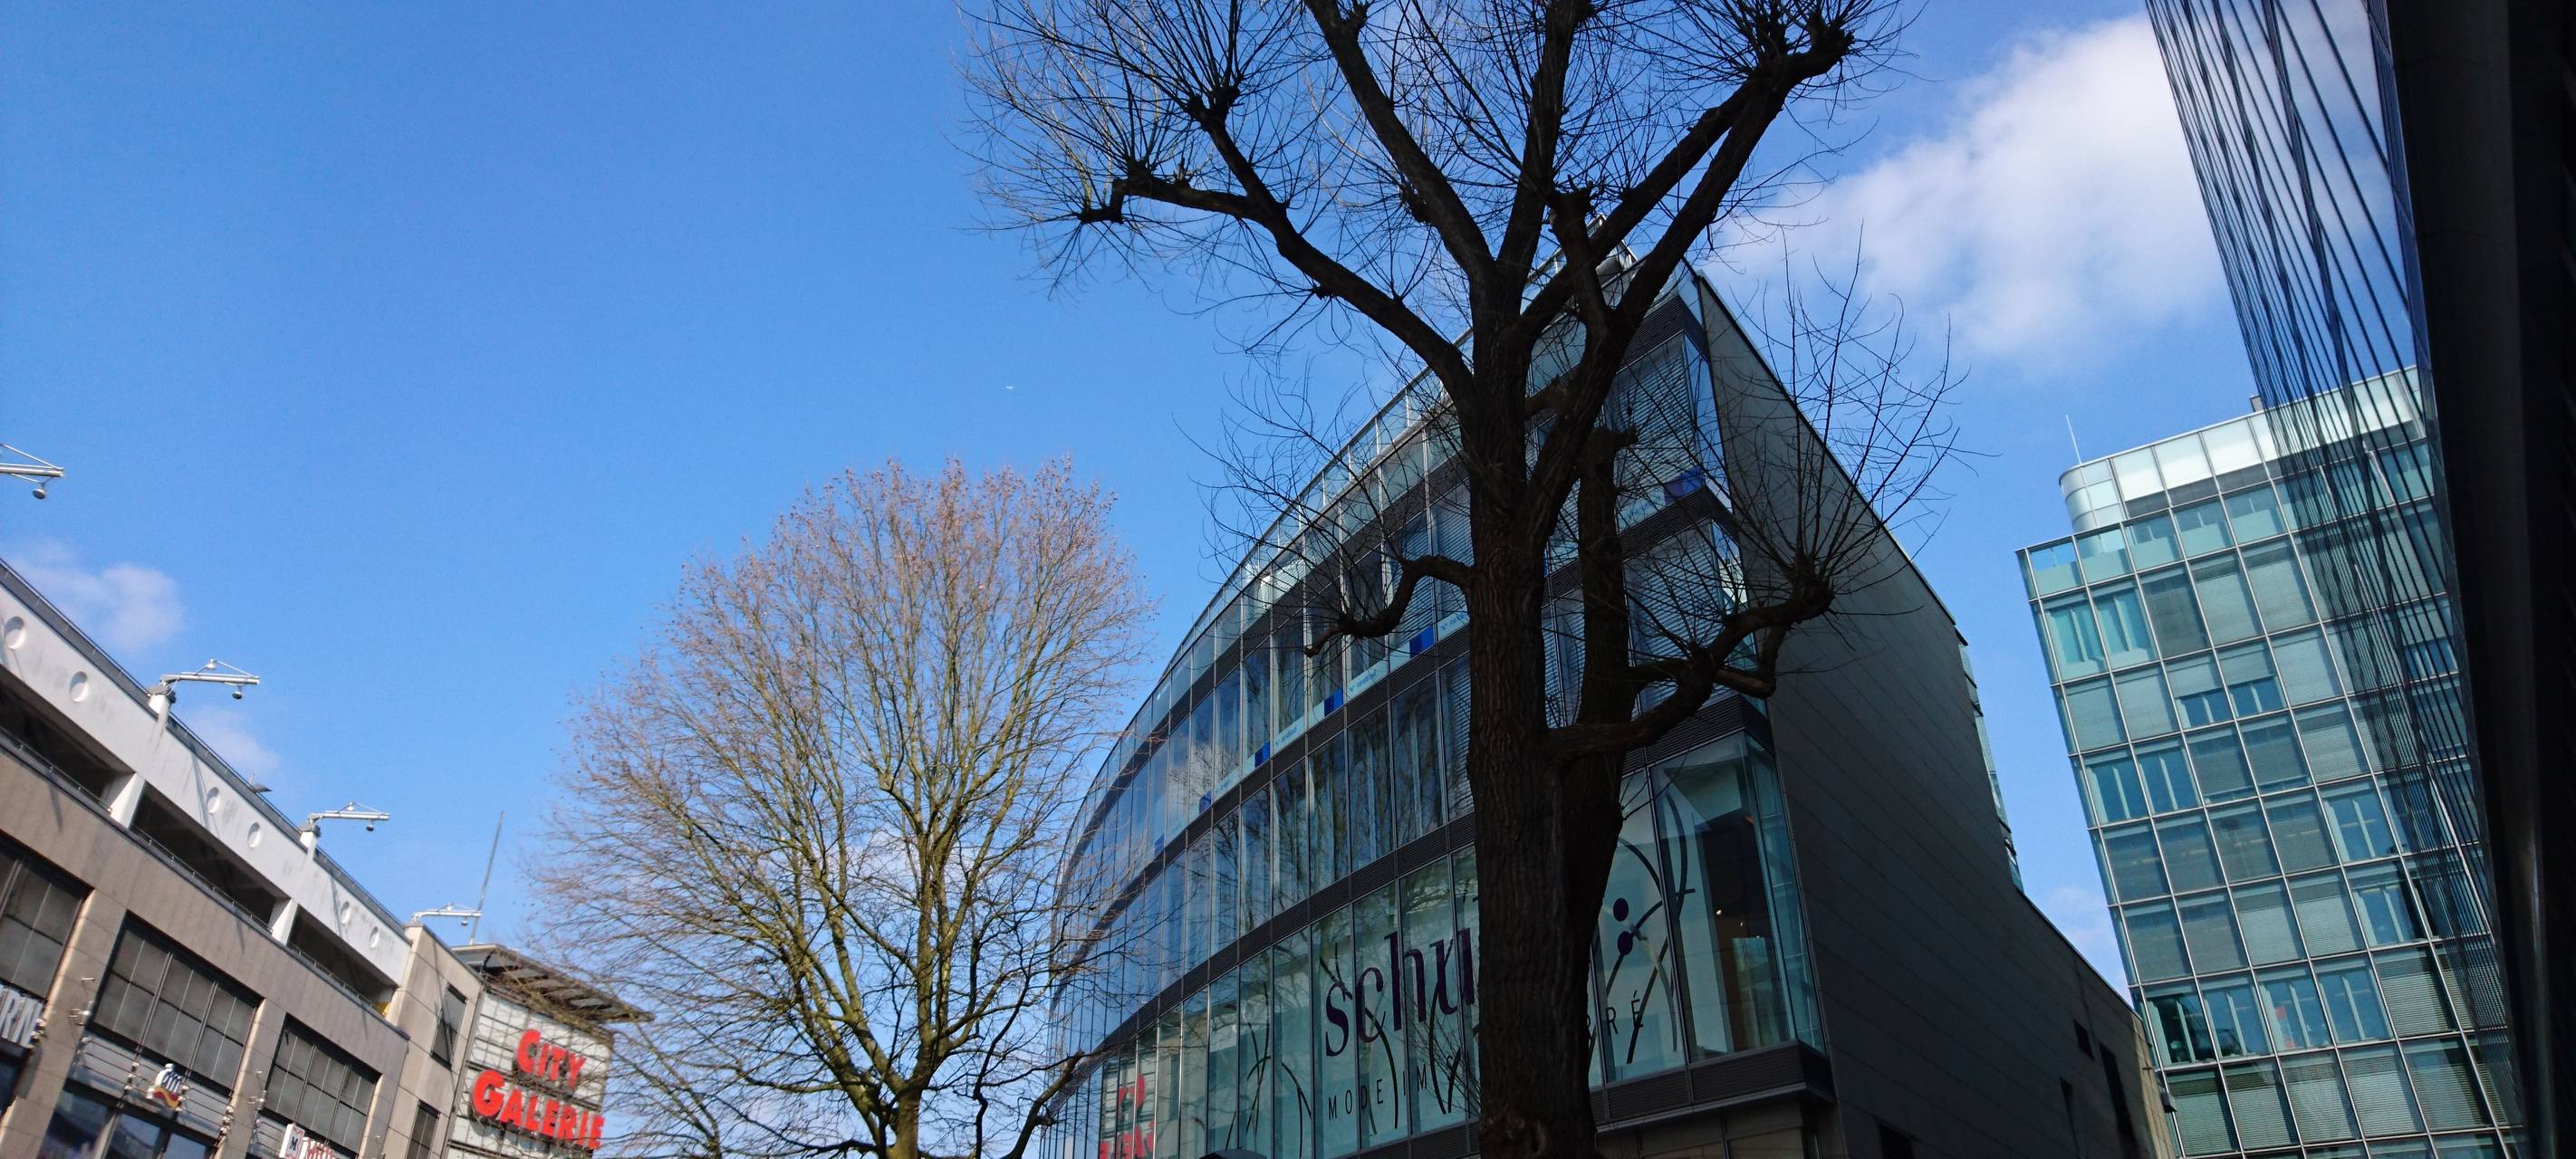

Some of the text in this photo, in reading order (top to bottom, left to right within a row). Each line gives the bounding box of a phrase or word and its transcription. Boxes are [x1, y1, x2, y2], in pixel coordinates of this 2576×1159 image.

[1325, 927, 1475, 1057] schu
[516, 1029, 587, 1088] CITY
[473, 1069, 605, 1151] GALERIE
[1328, 1079, 1384, 1121] MODE
